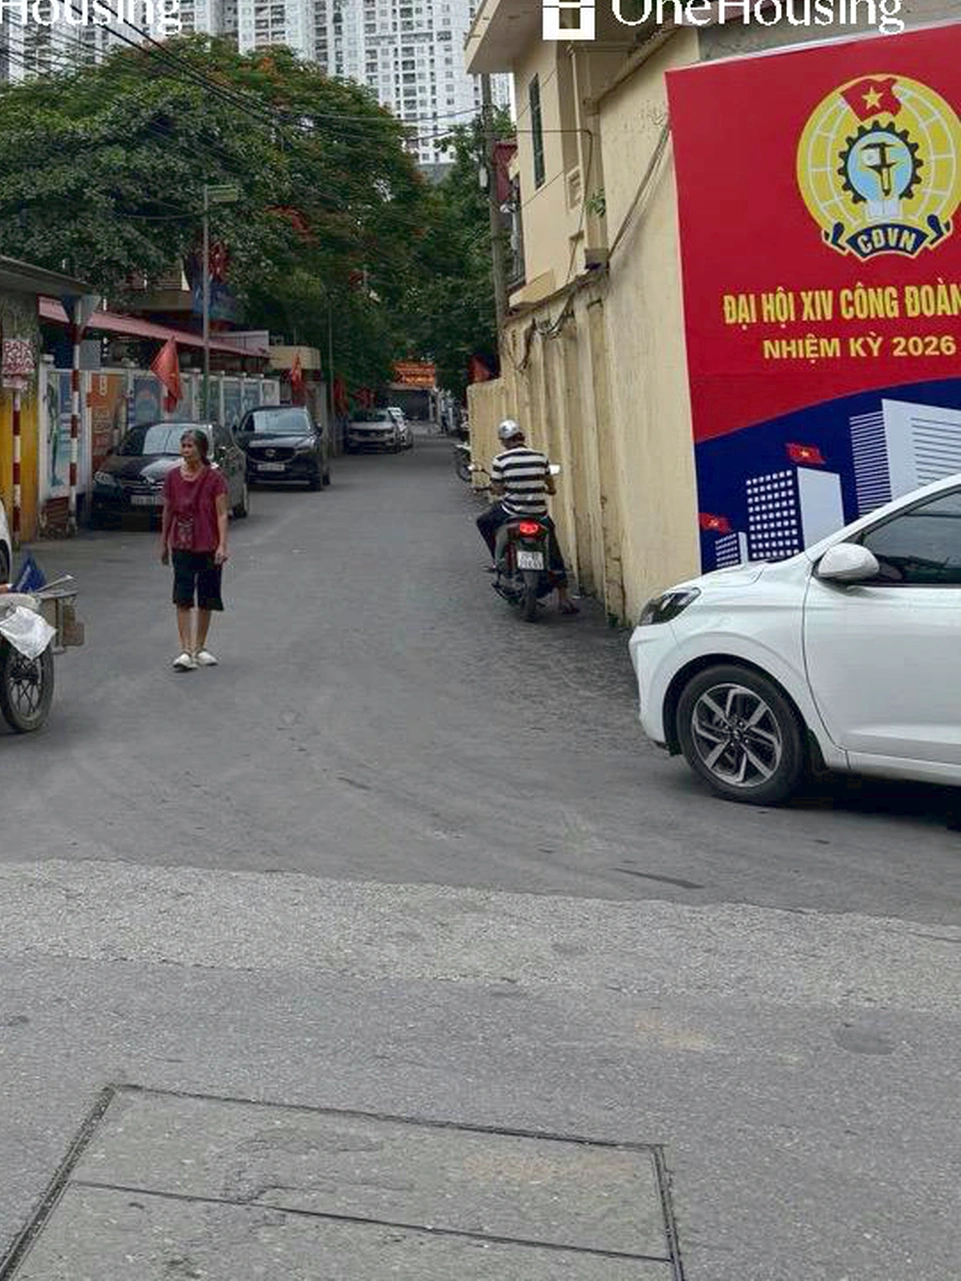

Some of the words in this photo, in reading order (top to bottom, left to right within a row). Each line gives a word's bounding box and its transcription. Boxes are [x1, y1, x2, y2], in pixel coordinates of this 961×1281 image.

[723, 294, 756, 330] ĐẠI
[761, 286, 795, 329] HỘI
[800, 290, 833, 321] XIV
[839, 281, 899, 321] CÔNG
[904, 277, 961, 318] ĐOÀN
[763, 333, 841, 364] NHIỆM
[849, 332, 883, 357] KỲ
[892, 335, 957, 357] 2026
